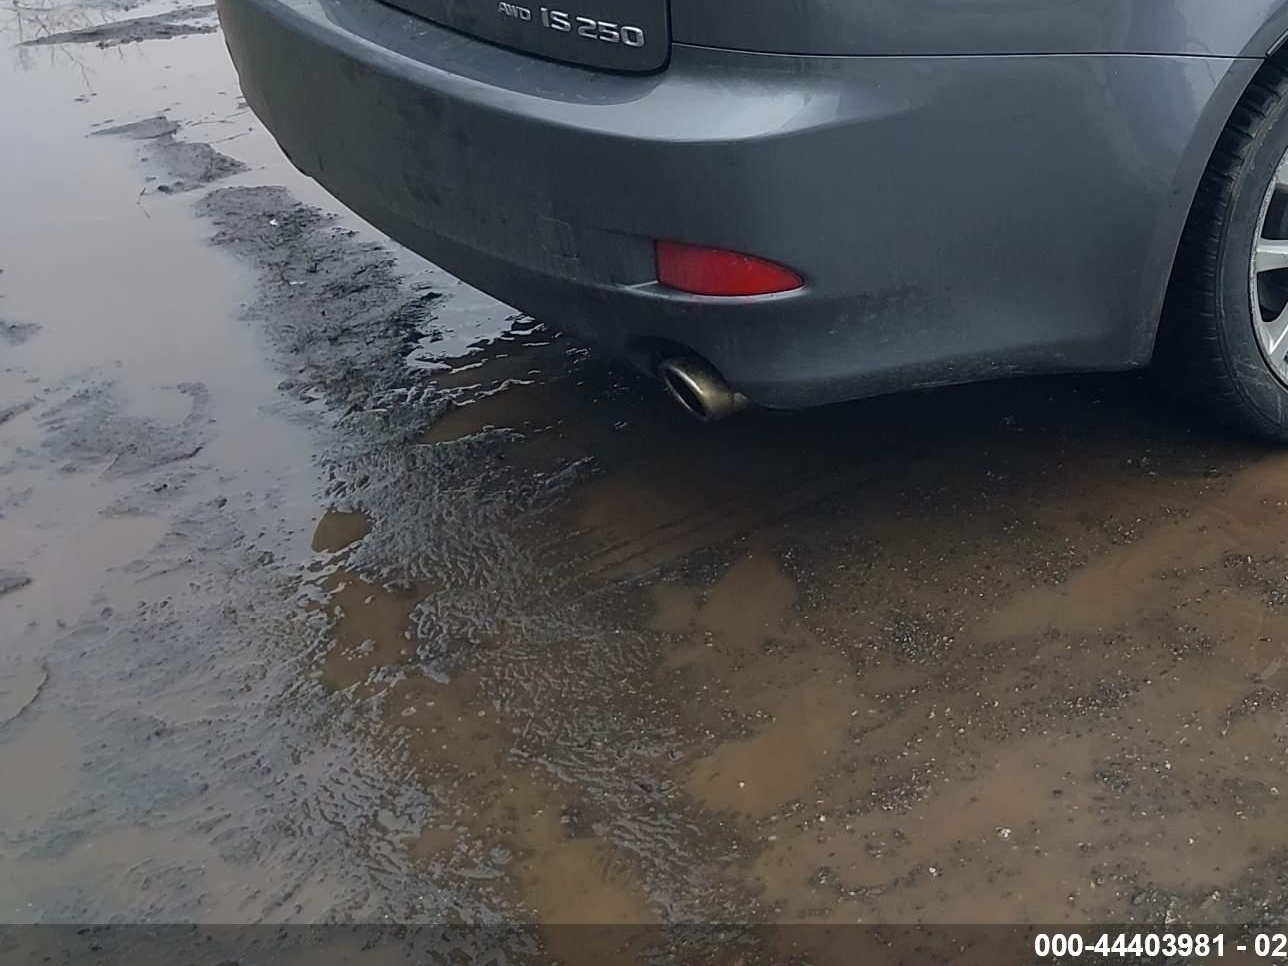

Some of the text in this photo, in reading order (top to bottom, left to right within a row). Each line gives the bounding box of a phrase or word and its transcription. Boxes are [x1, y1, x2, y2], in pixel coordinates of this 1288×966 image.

[497, 1, 645, 48] AWD IS 250
